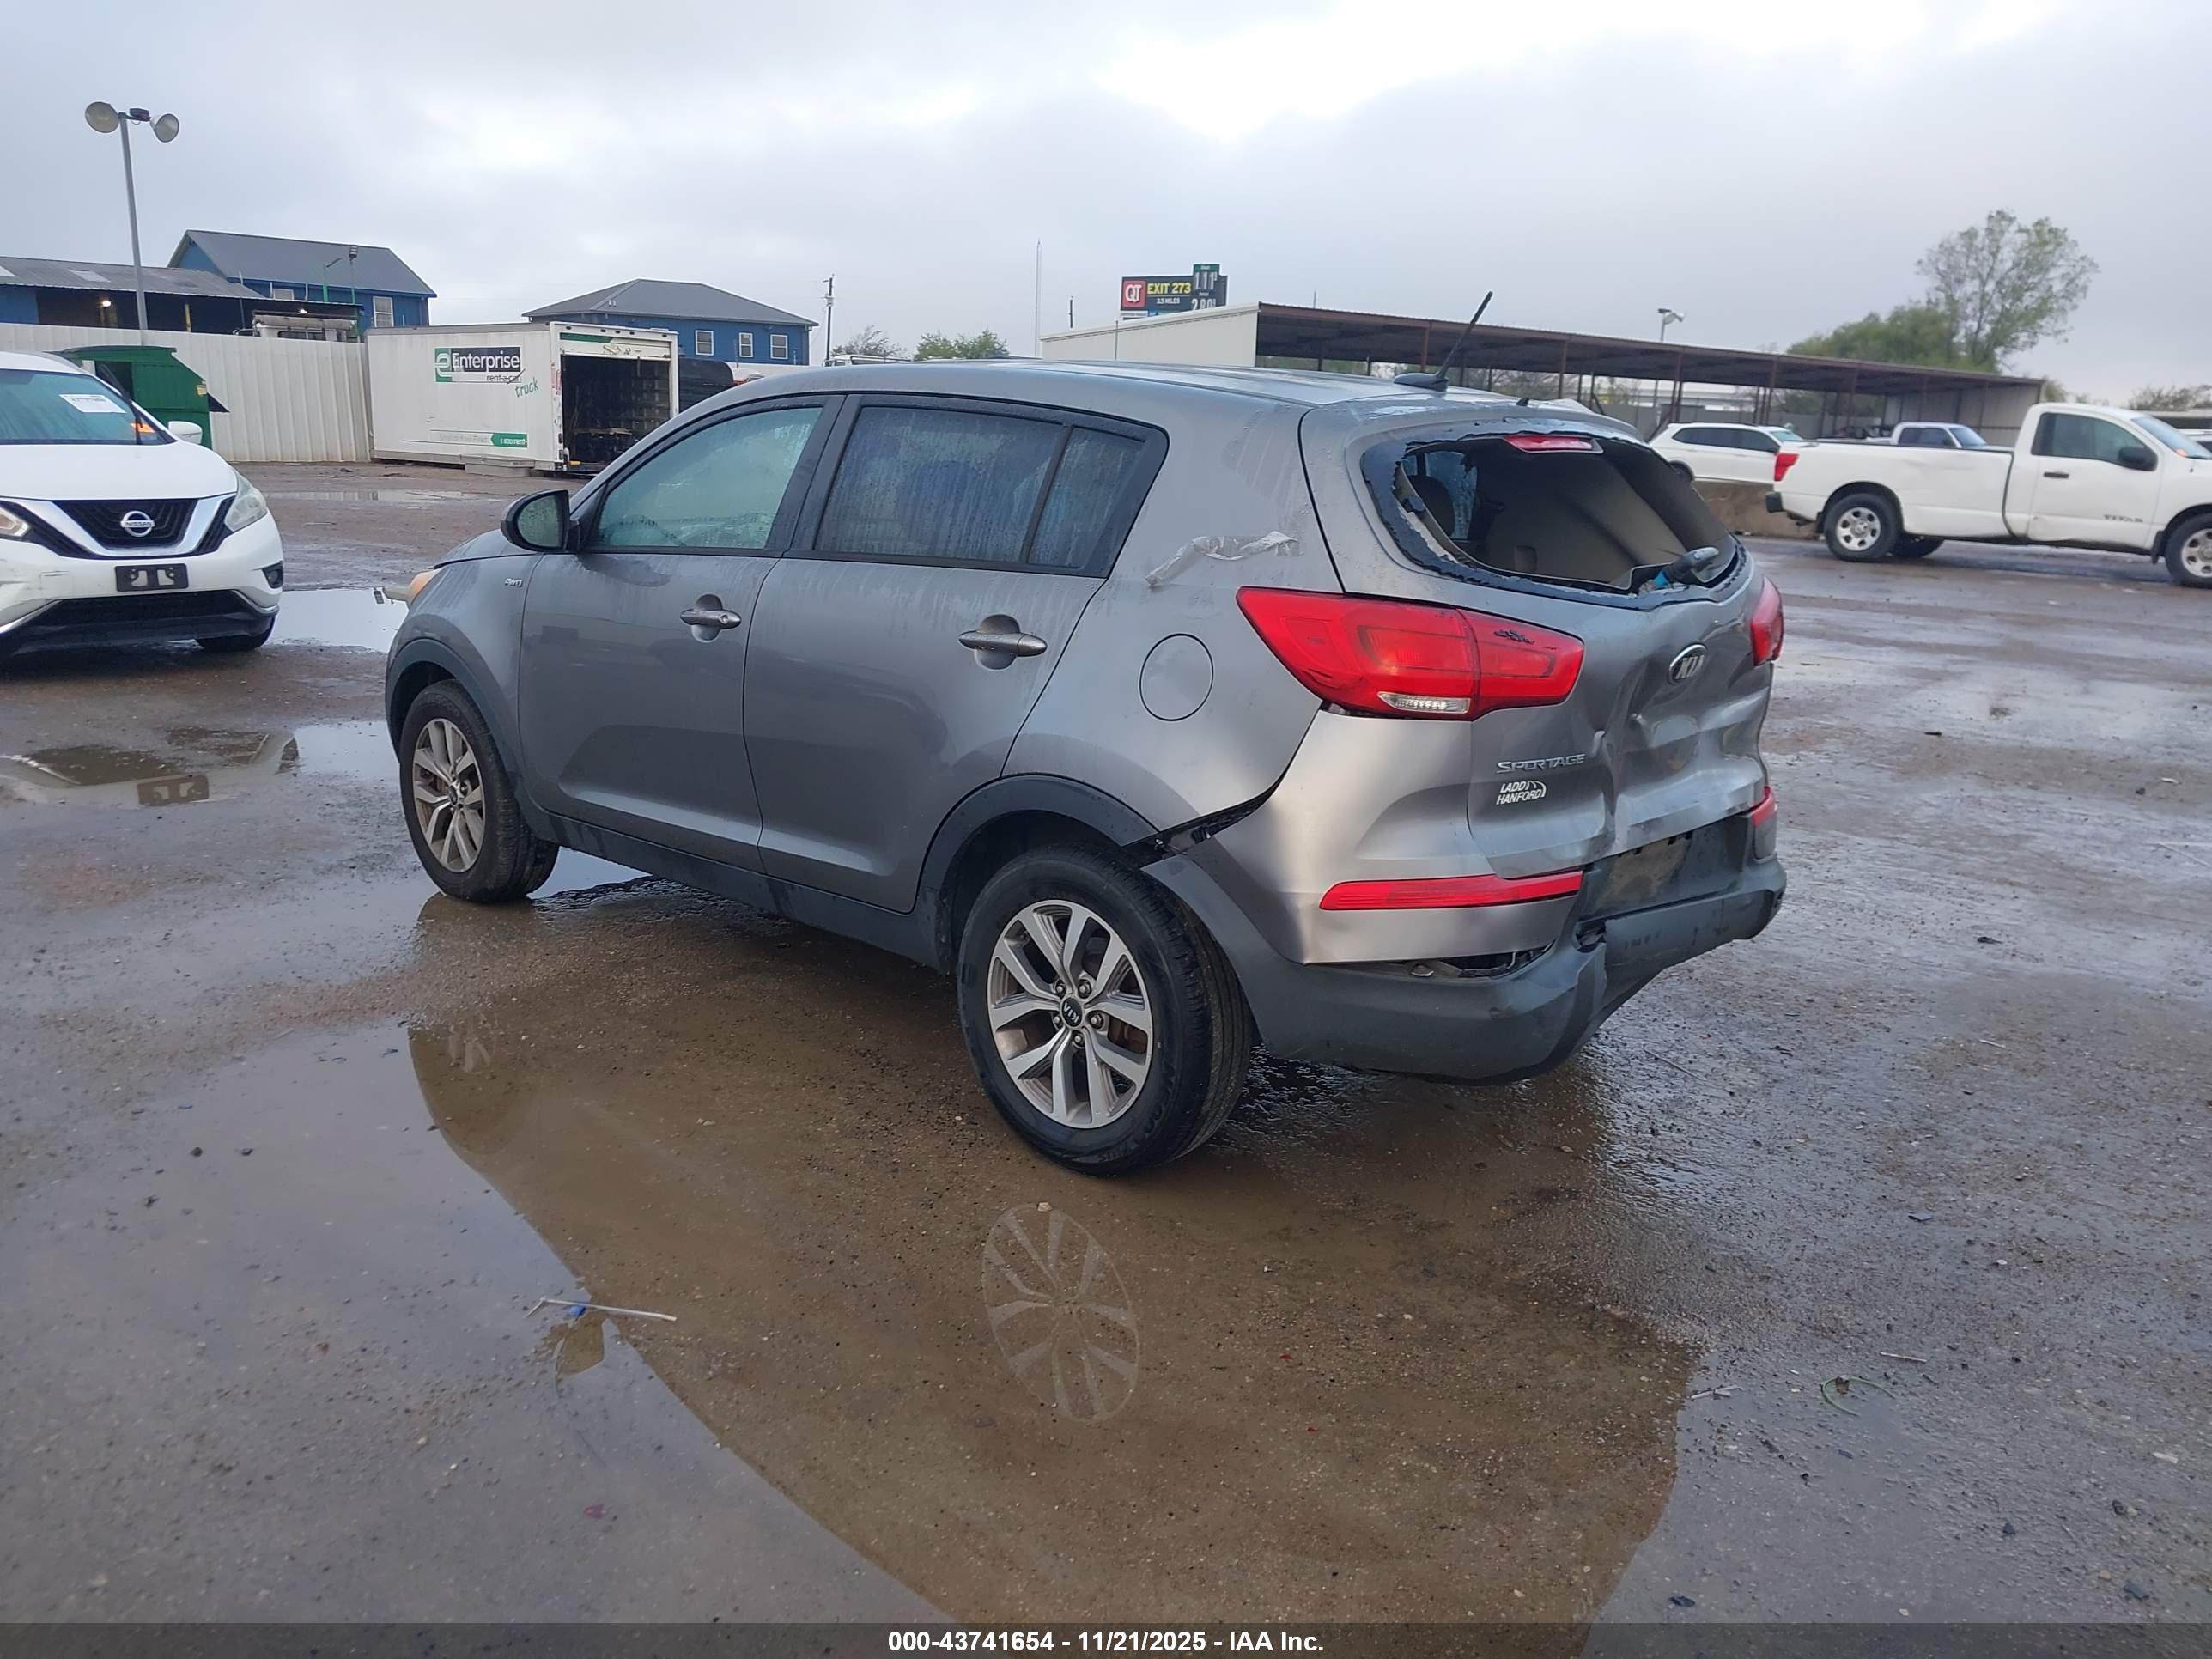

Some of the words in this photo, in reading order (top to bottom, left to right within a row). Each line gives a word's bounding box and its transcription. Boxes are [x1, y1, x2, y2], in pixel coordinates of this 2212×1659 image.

[1125, 284, 1142, 302] QT
[1147, 283, 1170, 295] EXIT
[1171, 283, 1192, 294] 273
[452, 350, 520, 371] Enterprise
[515, 378, 539, 398] truck
[1674, 654, 1705, 679] KIA
[1497, 753, 1586, 774] SPORTAGE
[1496, 788, 1543, 805] HANFORD
[1500, 781, 1529, 793] LADD
